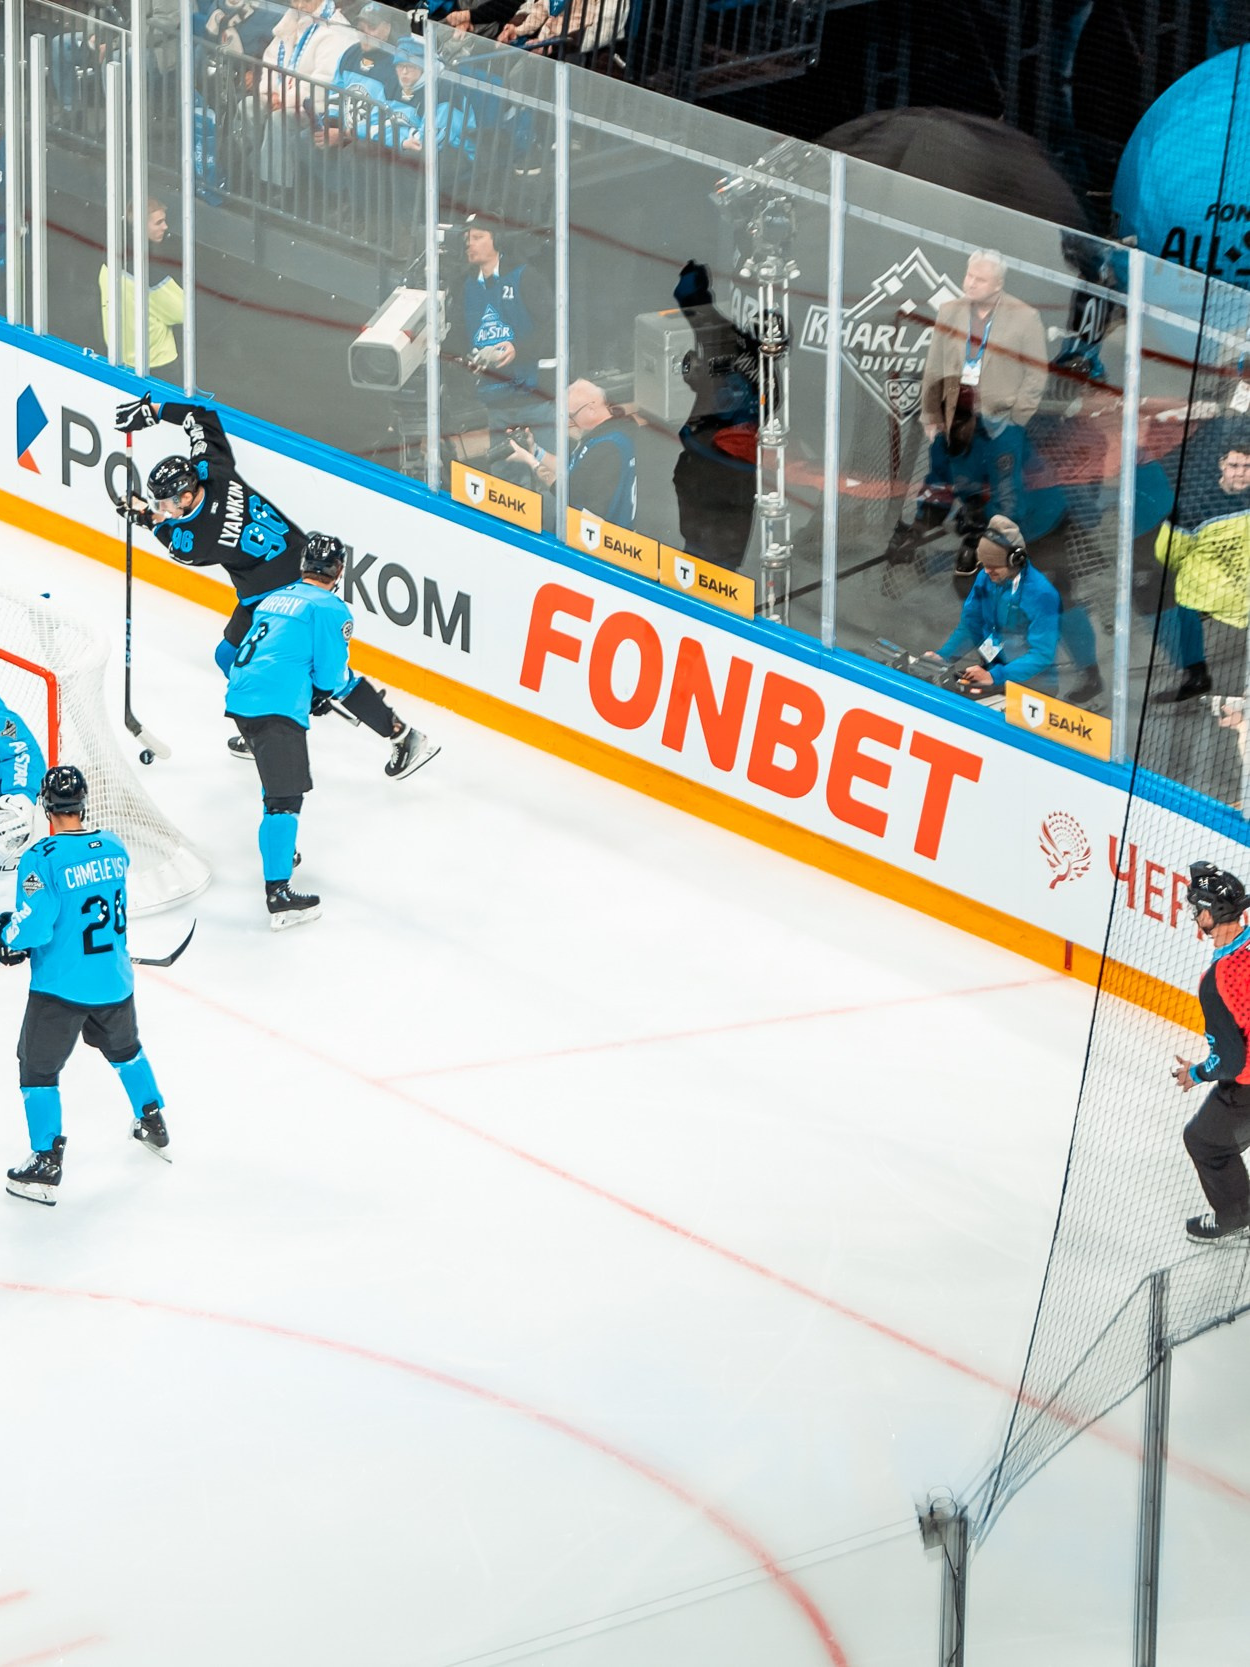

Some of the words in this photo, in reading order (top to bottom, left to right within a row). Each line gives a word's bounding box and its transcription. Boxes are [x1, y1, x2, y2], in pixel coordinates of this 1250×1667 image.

[502, 286, 514, 299] 21
[860, 355, 925, 372] DIVISI
[218, 480, 245, 548] LYAMKIN
[489, 488, 526, 515] БАНК
[240, 494, 290, 561] 96
[604, 535, 642, 561] БАНК
[698, 574, 738, 600] БАНК
[234, 621, 269, 668] 8
[519, 582, 984, 861] FONBET
[1048, 712, 1092, 741] БАНК
[1108, 834, 1204, 942] ЧЕР
